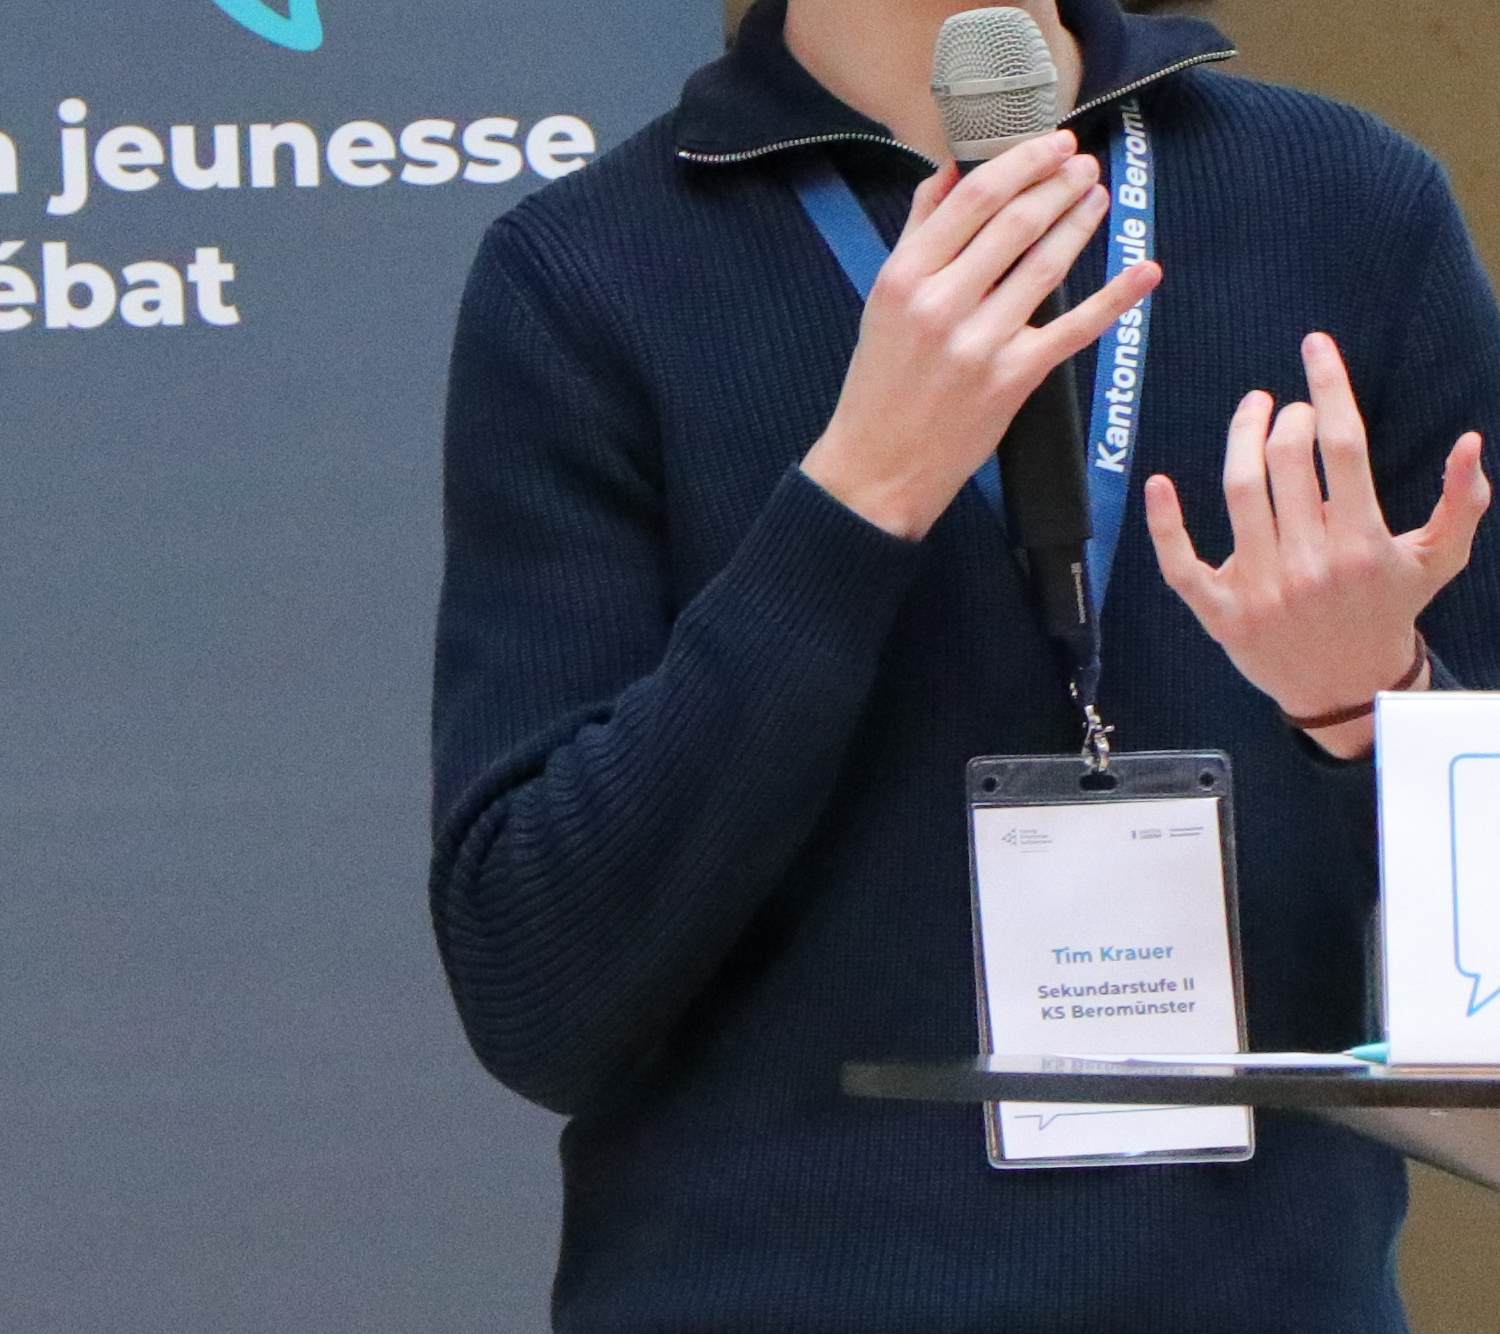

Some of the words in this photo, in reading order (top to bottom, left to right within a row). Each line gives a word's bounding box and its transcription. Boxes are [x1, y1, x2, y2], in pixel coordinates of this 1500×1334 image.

[46, 97, 599, 217] jeunesse
[1096, 218, 1147, 472] Kantonssule
[1051, 947, 1093, 965] Tim
[1099, 944, 1174, 962] Krauer
[1037, 979, 1179, 999] Sekundarstufe
[1041, 1004, 1066, 1020] KS
[1071, 1000, 1197, 1019] Beromünster
